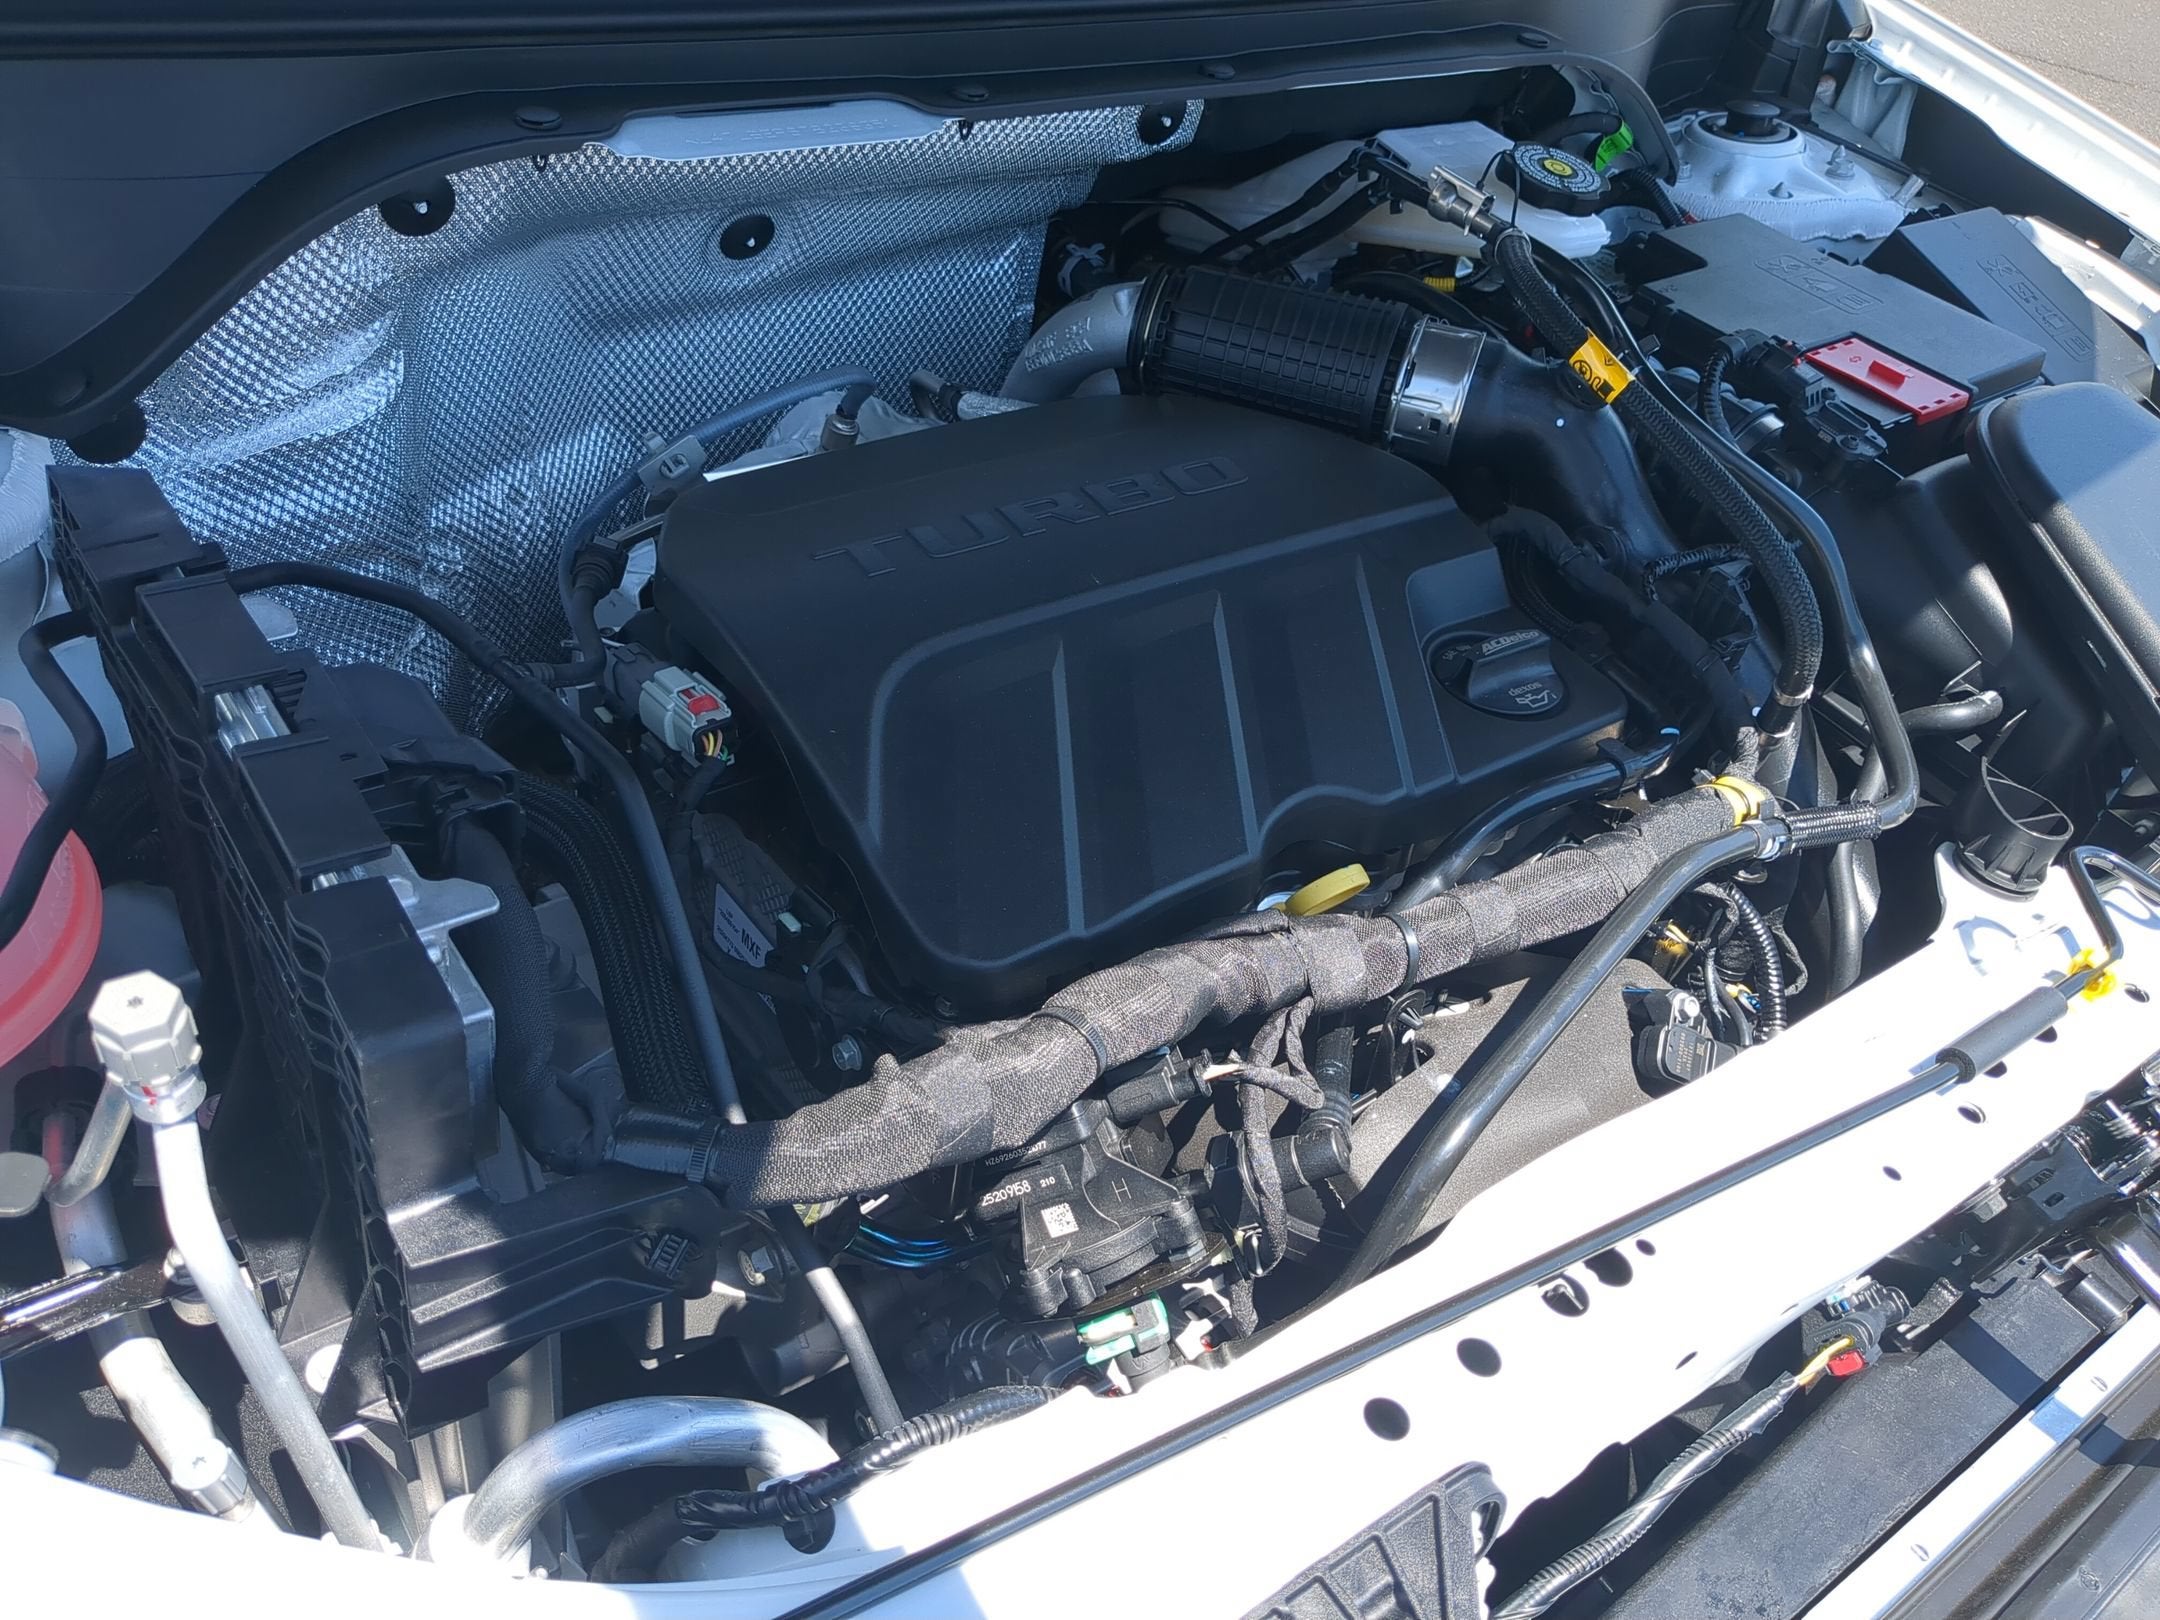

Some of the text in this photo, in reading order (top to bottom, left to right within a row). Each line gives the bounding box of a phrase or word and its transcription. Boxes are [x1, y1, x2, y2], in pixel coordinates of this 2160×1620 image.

[812, 456, 1249, 577] TURBO
[1481, 630, 1539, 653] ACDelco
[1508, 681, 1543, 697] dexos
[1039, 1176, 1056, 1188] 210
